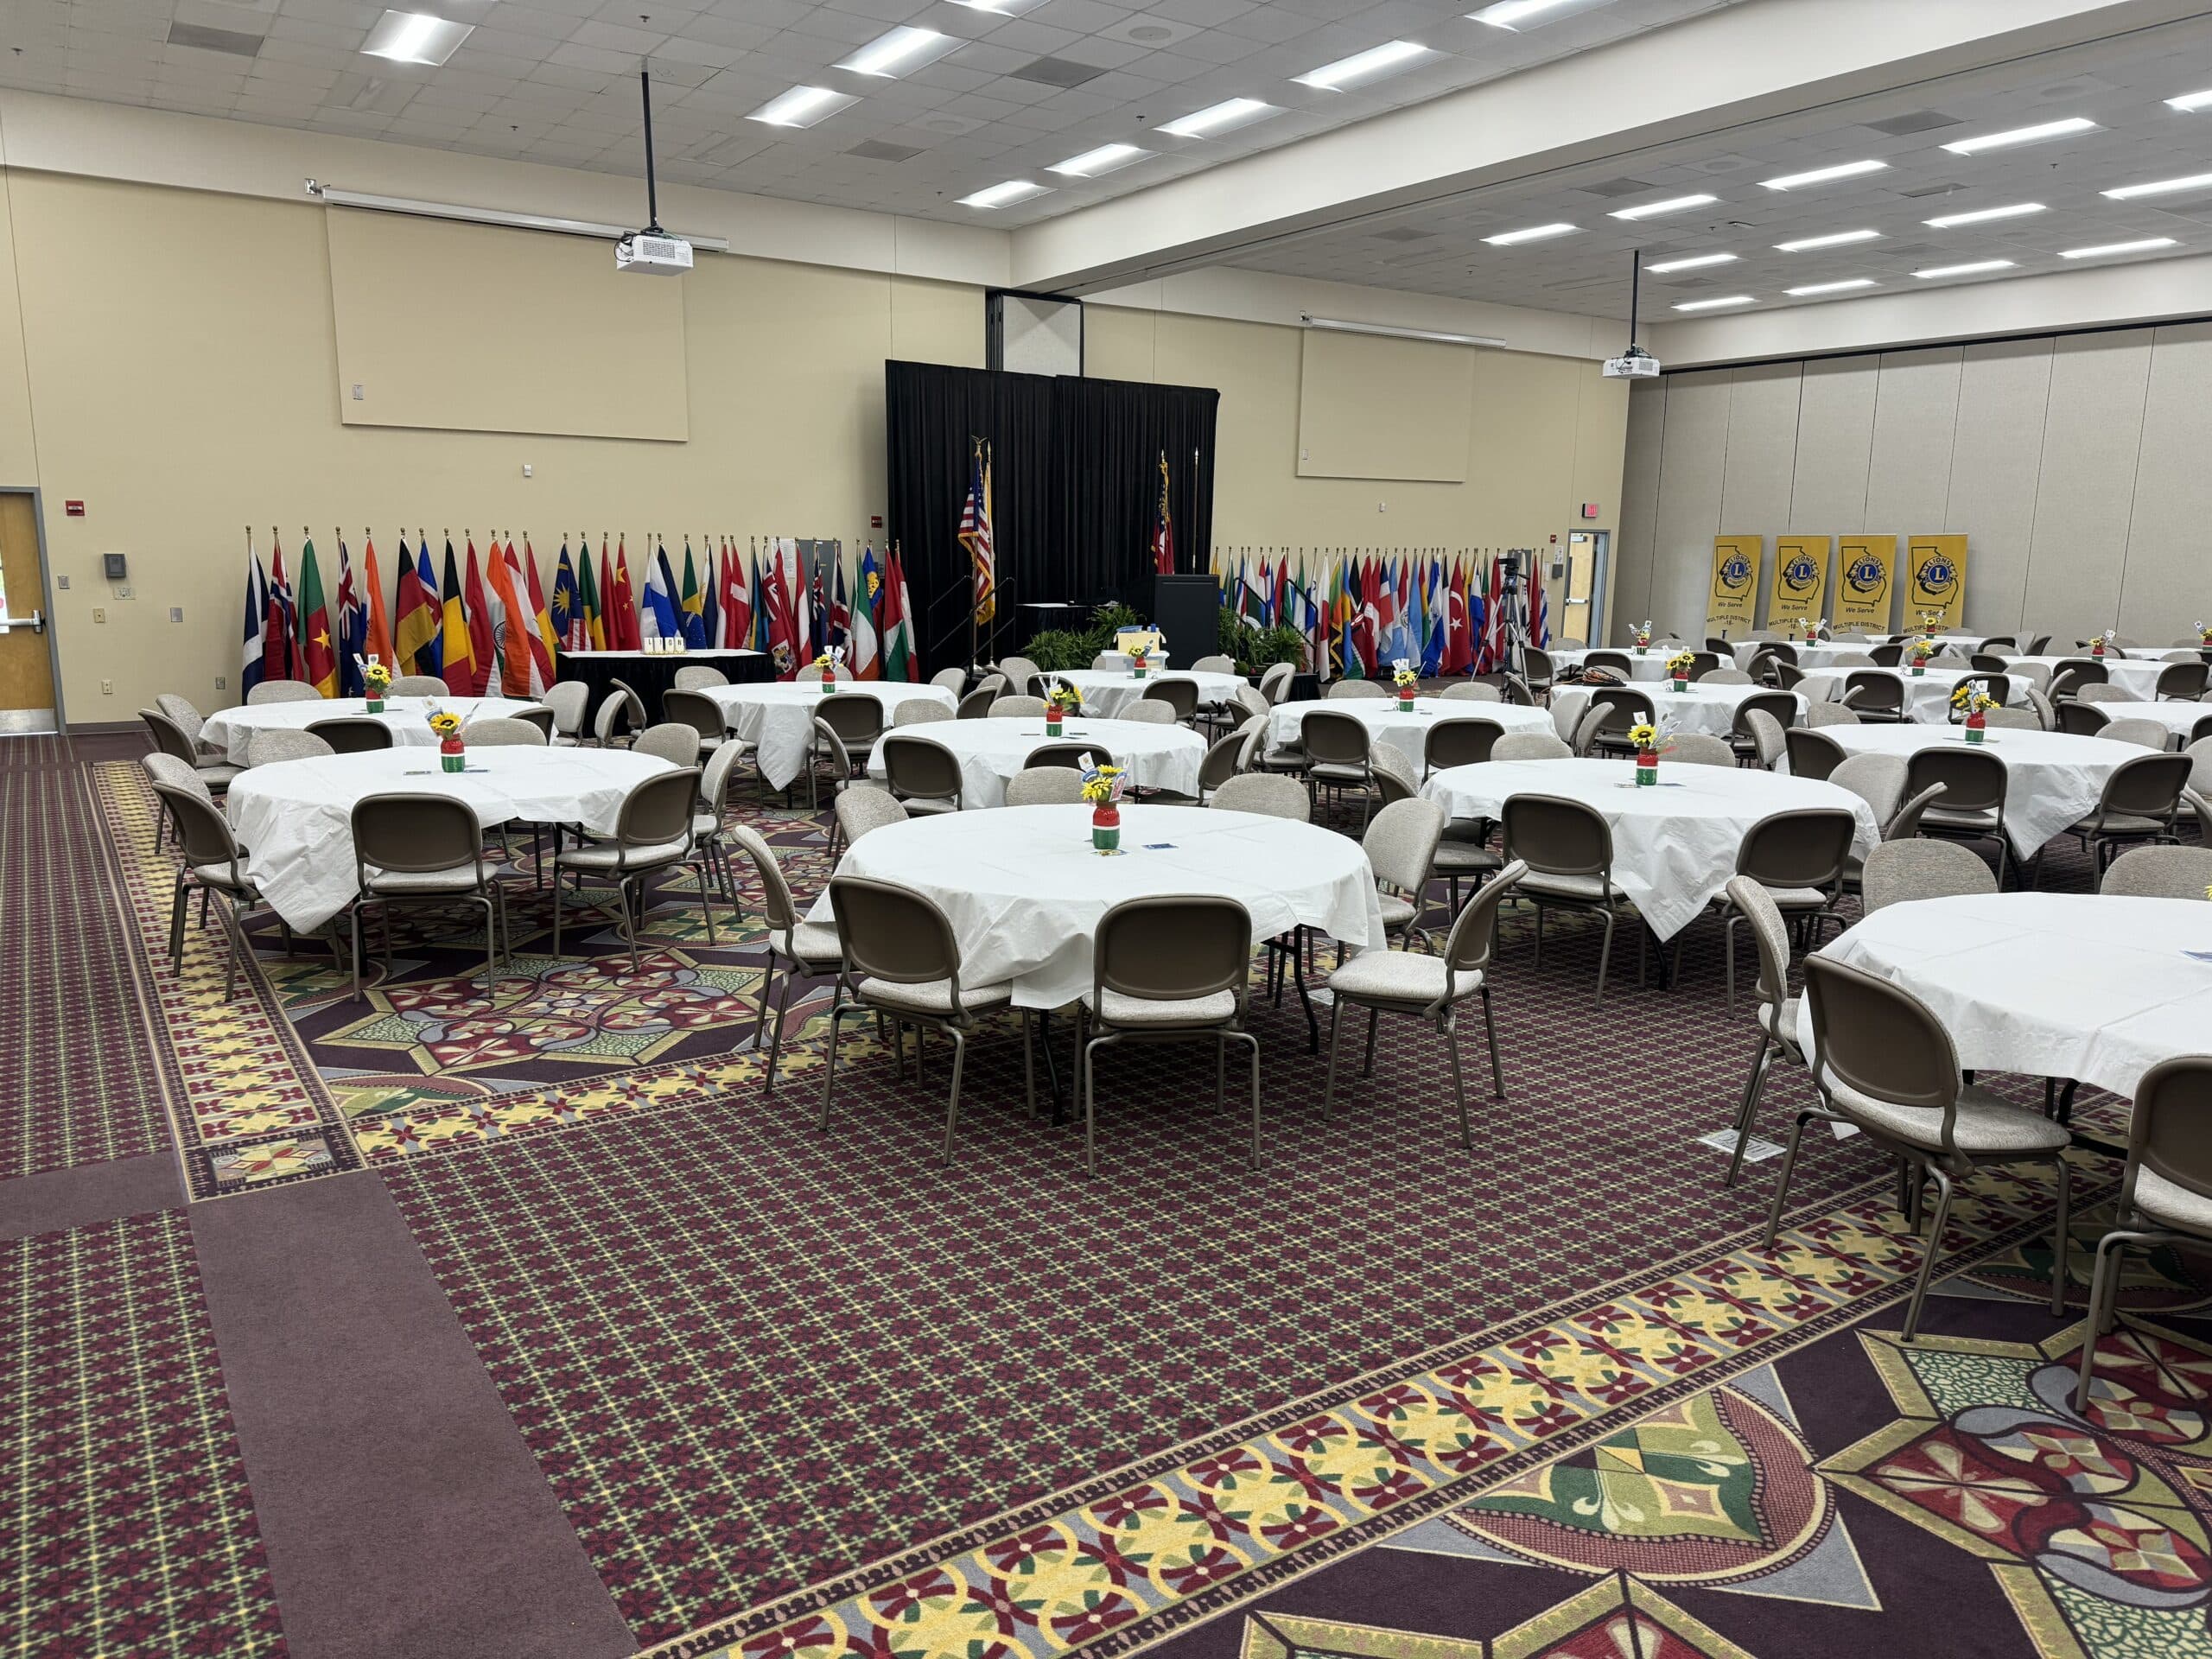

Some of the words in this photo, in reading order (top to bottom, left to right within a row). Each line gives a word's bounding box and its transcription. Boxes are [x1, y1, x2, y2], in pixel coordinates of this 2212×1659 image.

[1730, 555, 1748, 563] LIONS
[1795, 556, 1814, 564] LIONS
[1859, 556, 1879, 565] LIONS
[1733, 564, 1742, 575] L
[1798, 566, 1808, 577] L
[1863, 566, 1873, 579] L
[1934, 567, 1944, 580] L
[1730, 614, 1751, 625] DISTRICT
[1769, 618, 1793, 626] MULTIPLE
[1833, 621, 1859, 630] MULTIPLE
[1860, 621, 1885, 632] DISTRICT
[1903, 625, 1926, 633] MULTIPL
